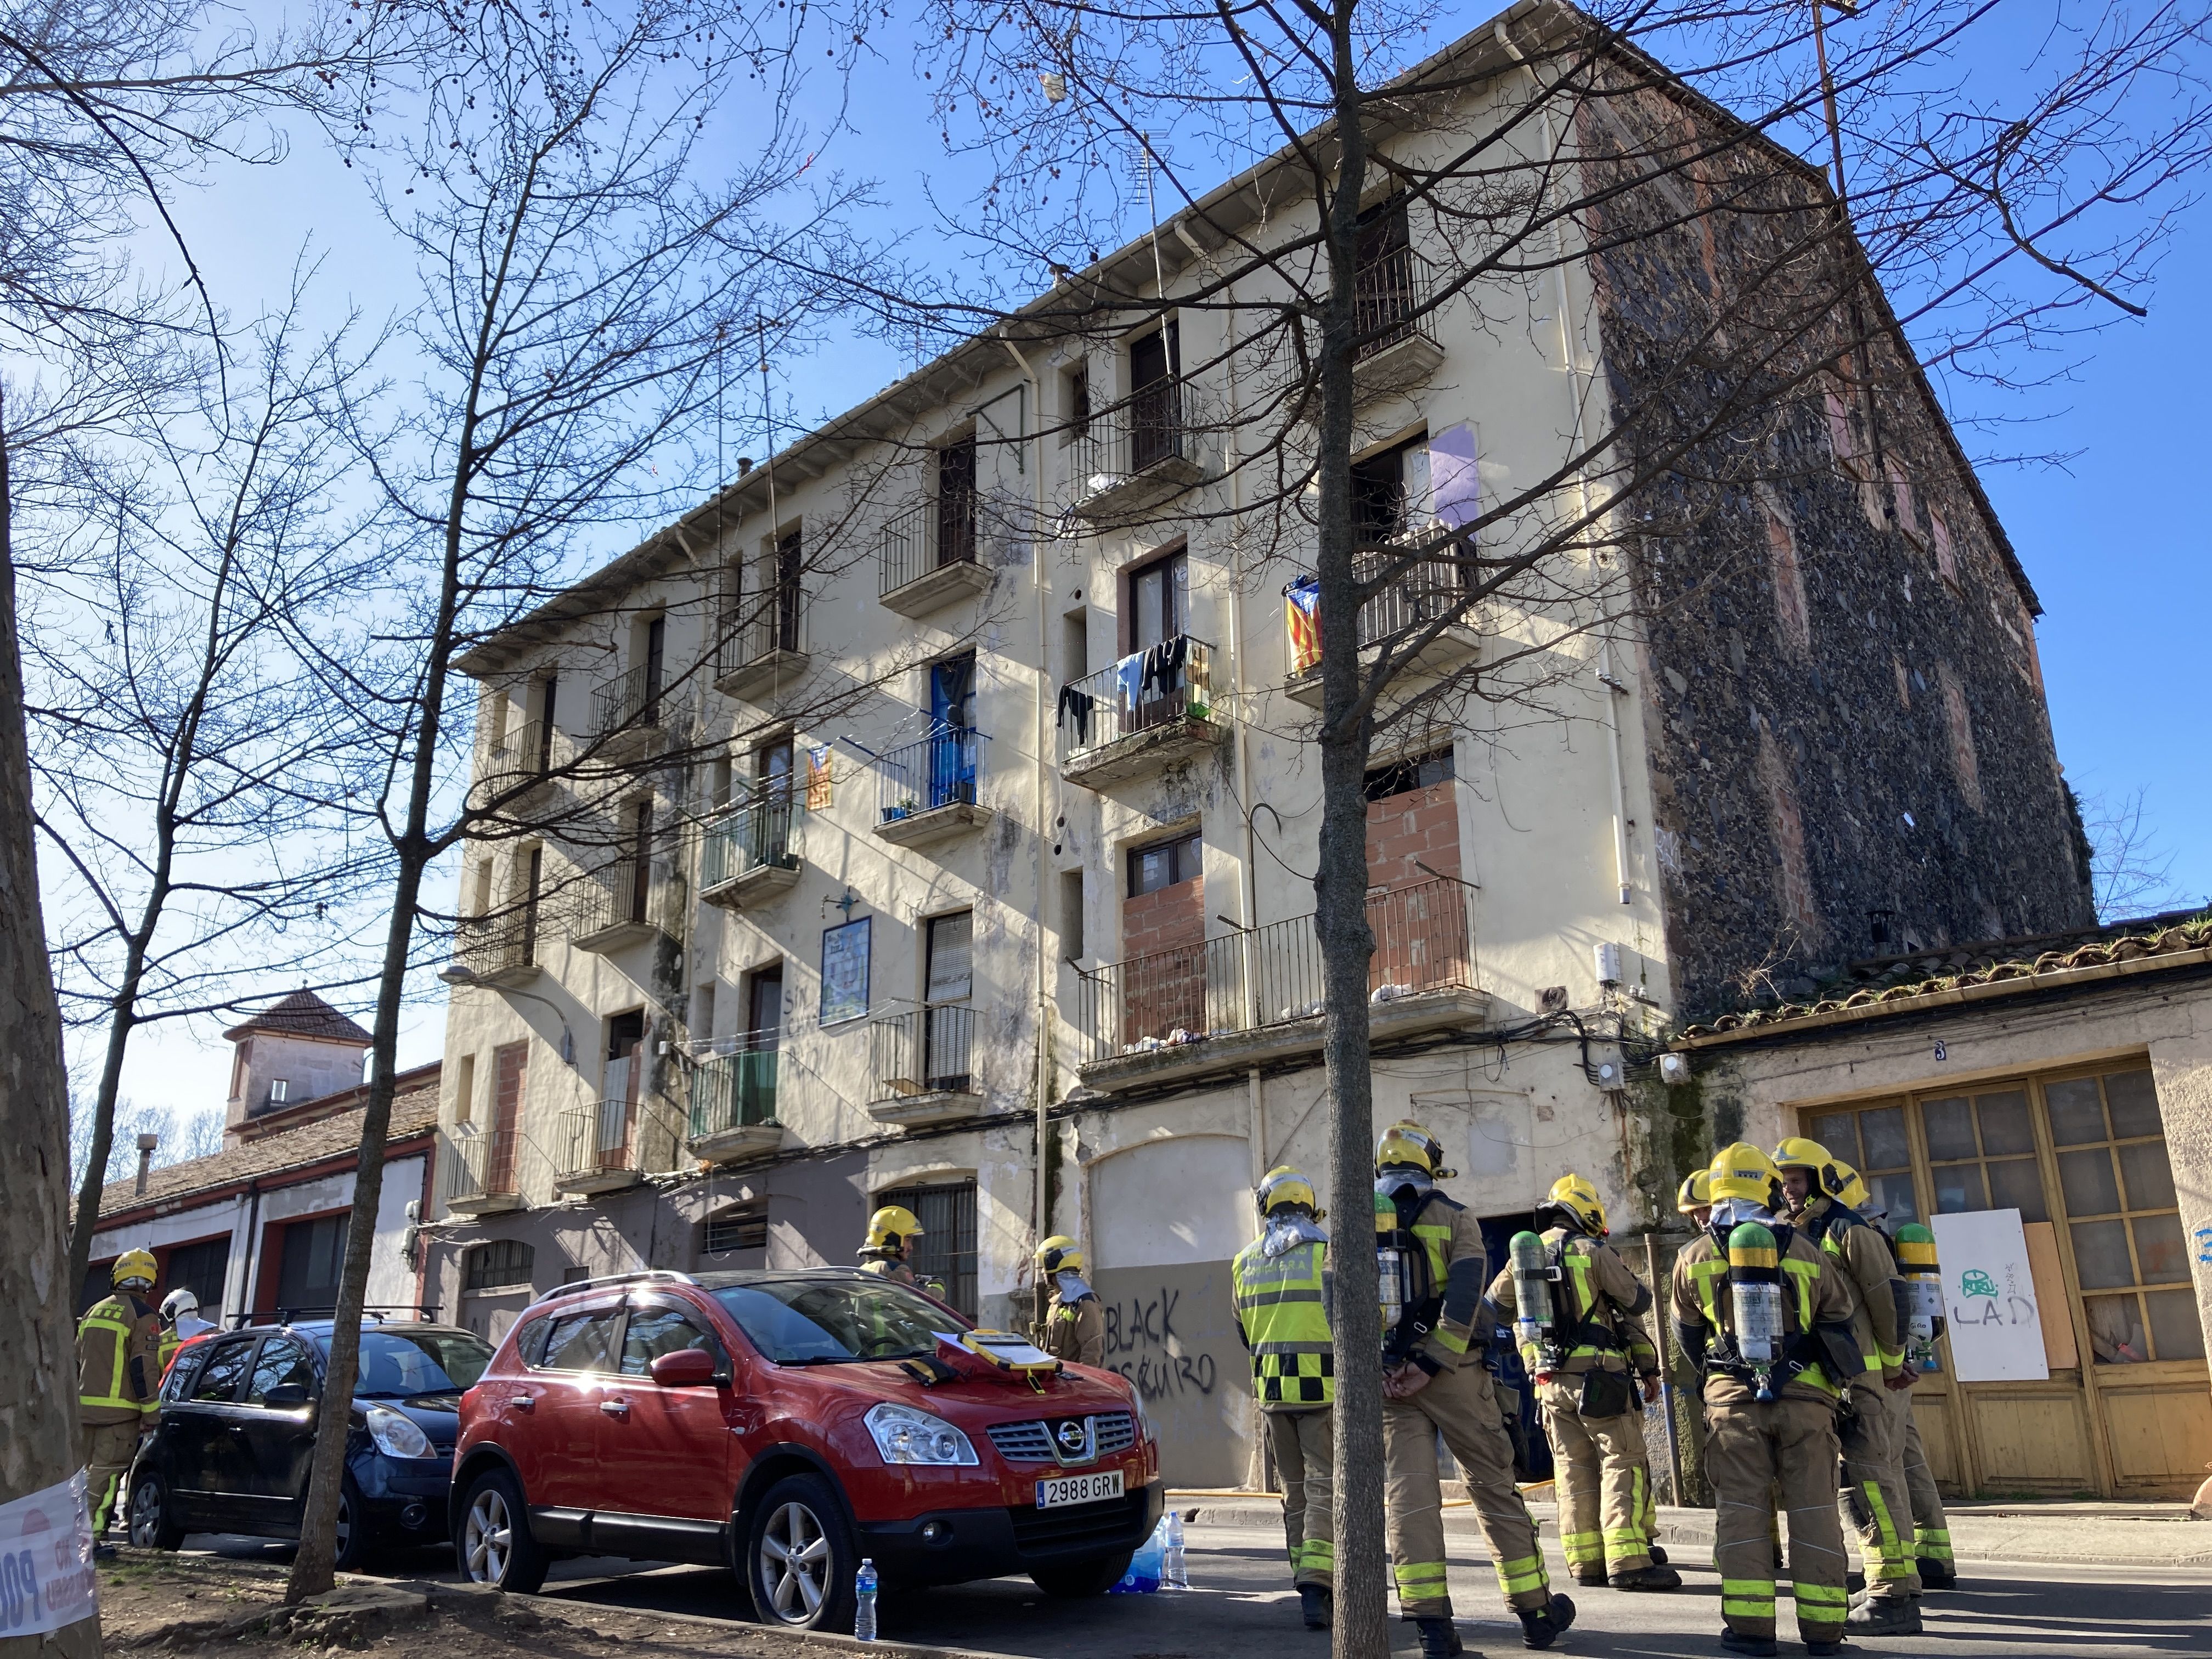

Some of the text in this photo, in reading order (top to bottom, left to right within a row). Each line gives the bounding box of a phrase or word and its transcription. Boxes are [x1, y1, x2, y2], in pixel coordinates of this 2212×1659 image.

[1936, 1041, 1945, 1060] 3
[1106, 1286, 1179, 1355] BLACK
[1954, 1297, 2035, 1327] LAD
[1049, 1479, 1088, 1504] 2988
[1092, 1474, 1120, 1498] GRW
